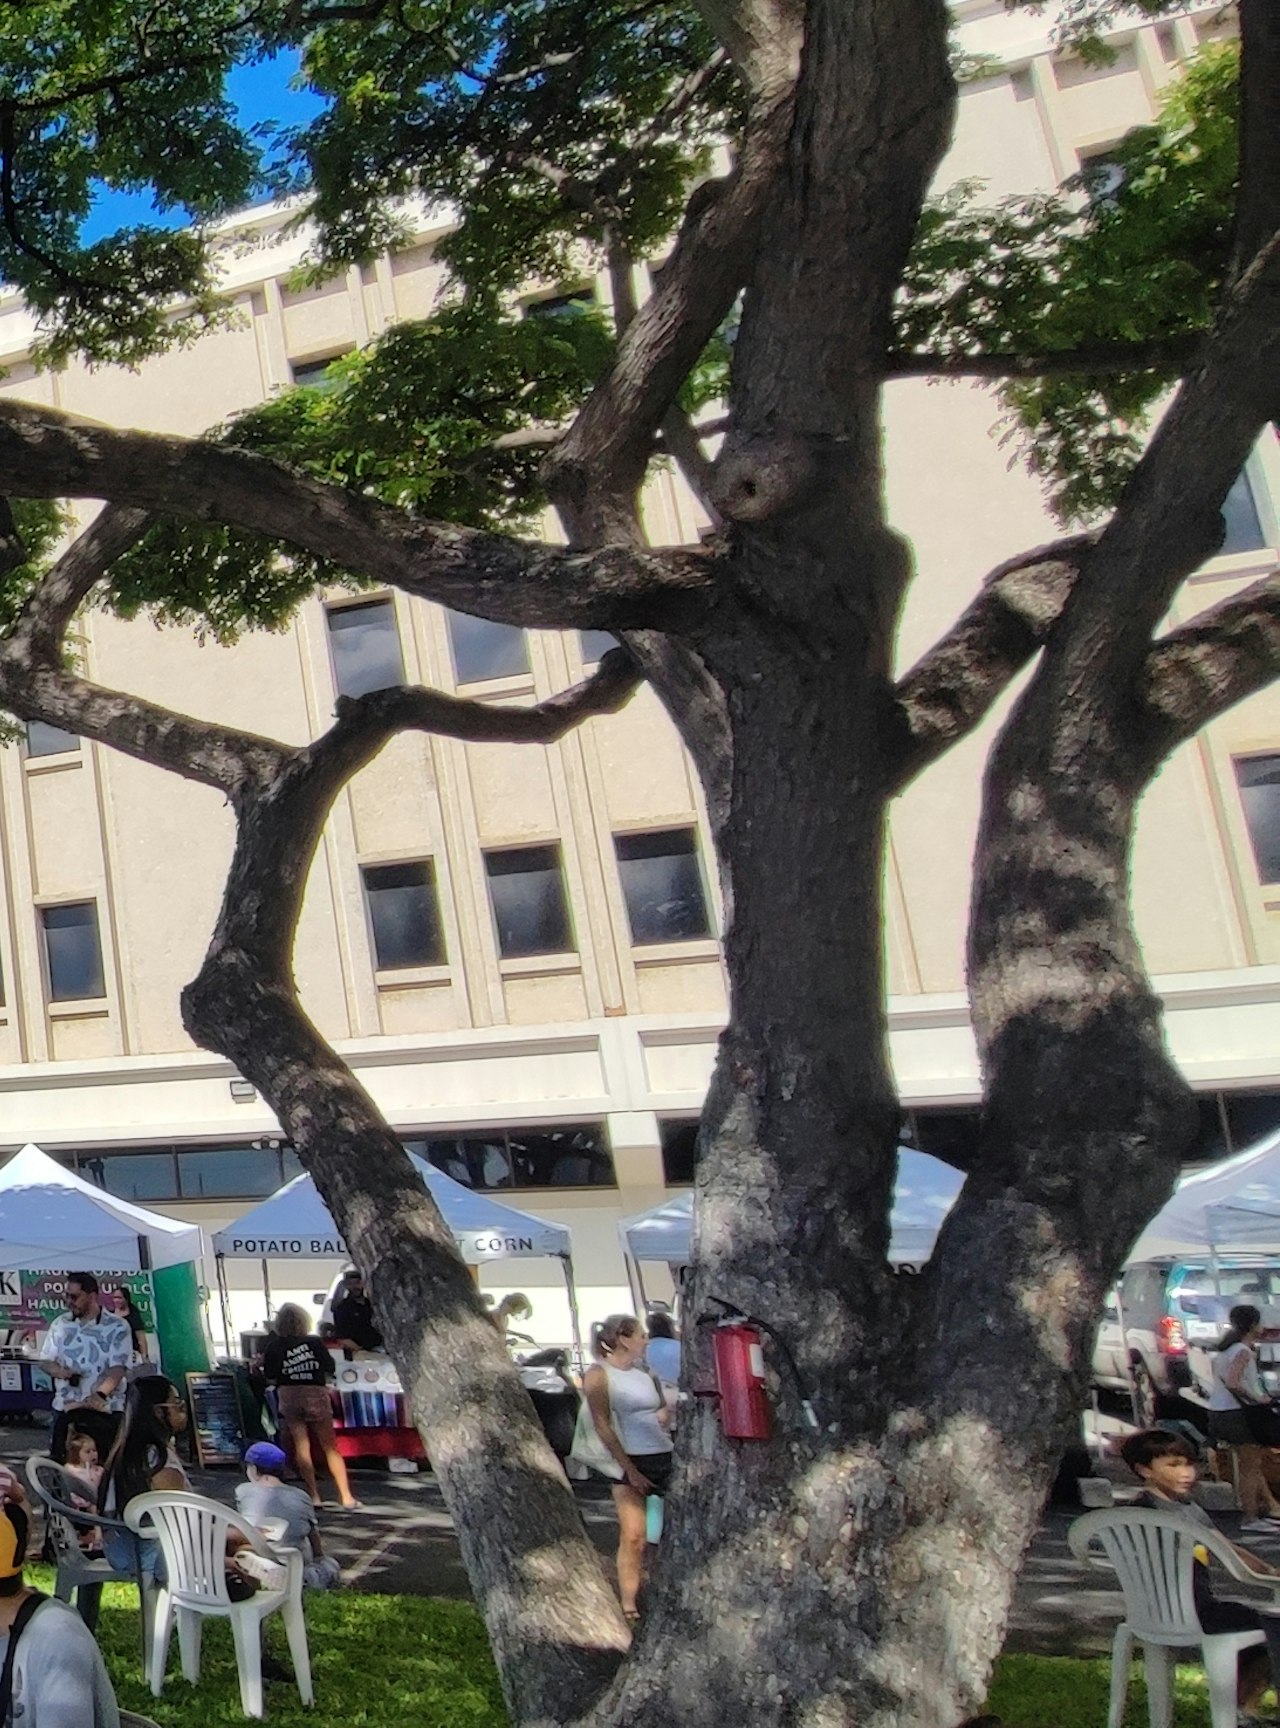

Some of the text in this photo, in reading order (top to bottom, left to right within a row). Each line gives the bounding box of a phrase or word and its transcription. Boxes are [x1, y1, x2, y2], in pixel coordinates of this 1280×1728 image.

[233, 1239, 346, 1253] POTATO BAL
[475, 1238, 533, 1252] CORN
[286, 1343, 310, 1358] ANTI
[282, 1350, 316, 1368] ANIMAL
